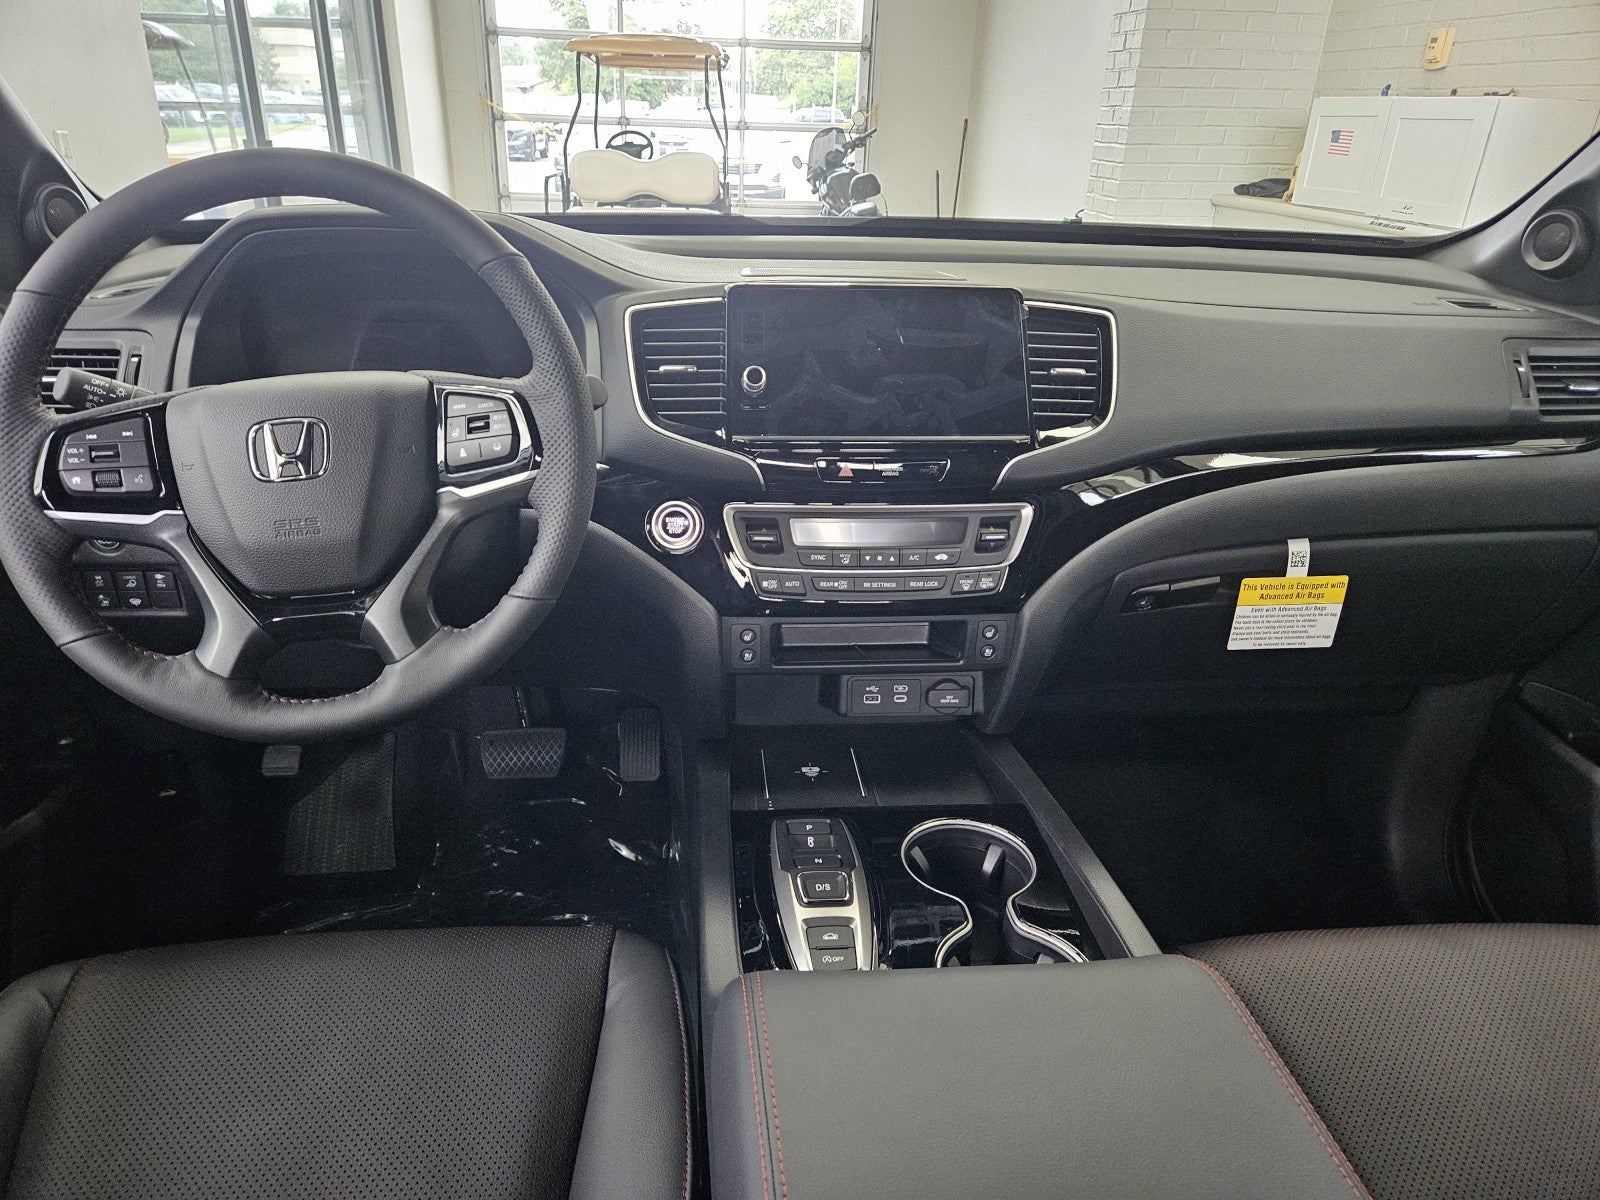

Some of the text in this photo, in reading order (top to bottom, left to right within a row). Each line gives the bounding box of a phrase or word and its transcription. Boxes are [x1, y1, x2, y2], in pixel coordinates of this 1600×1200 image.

[92, 378, 105, 386] OFF
[83, 384, 103, 394] AUTO
[1296, 582, 1329, 590] Equipped
